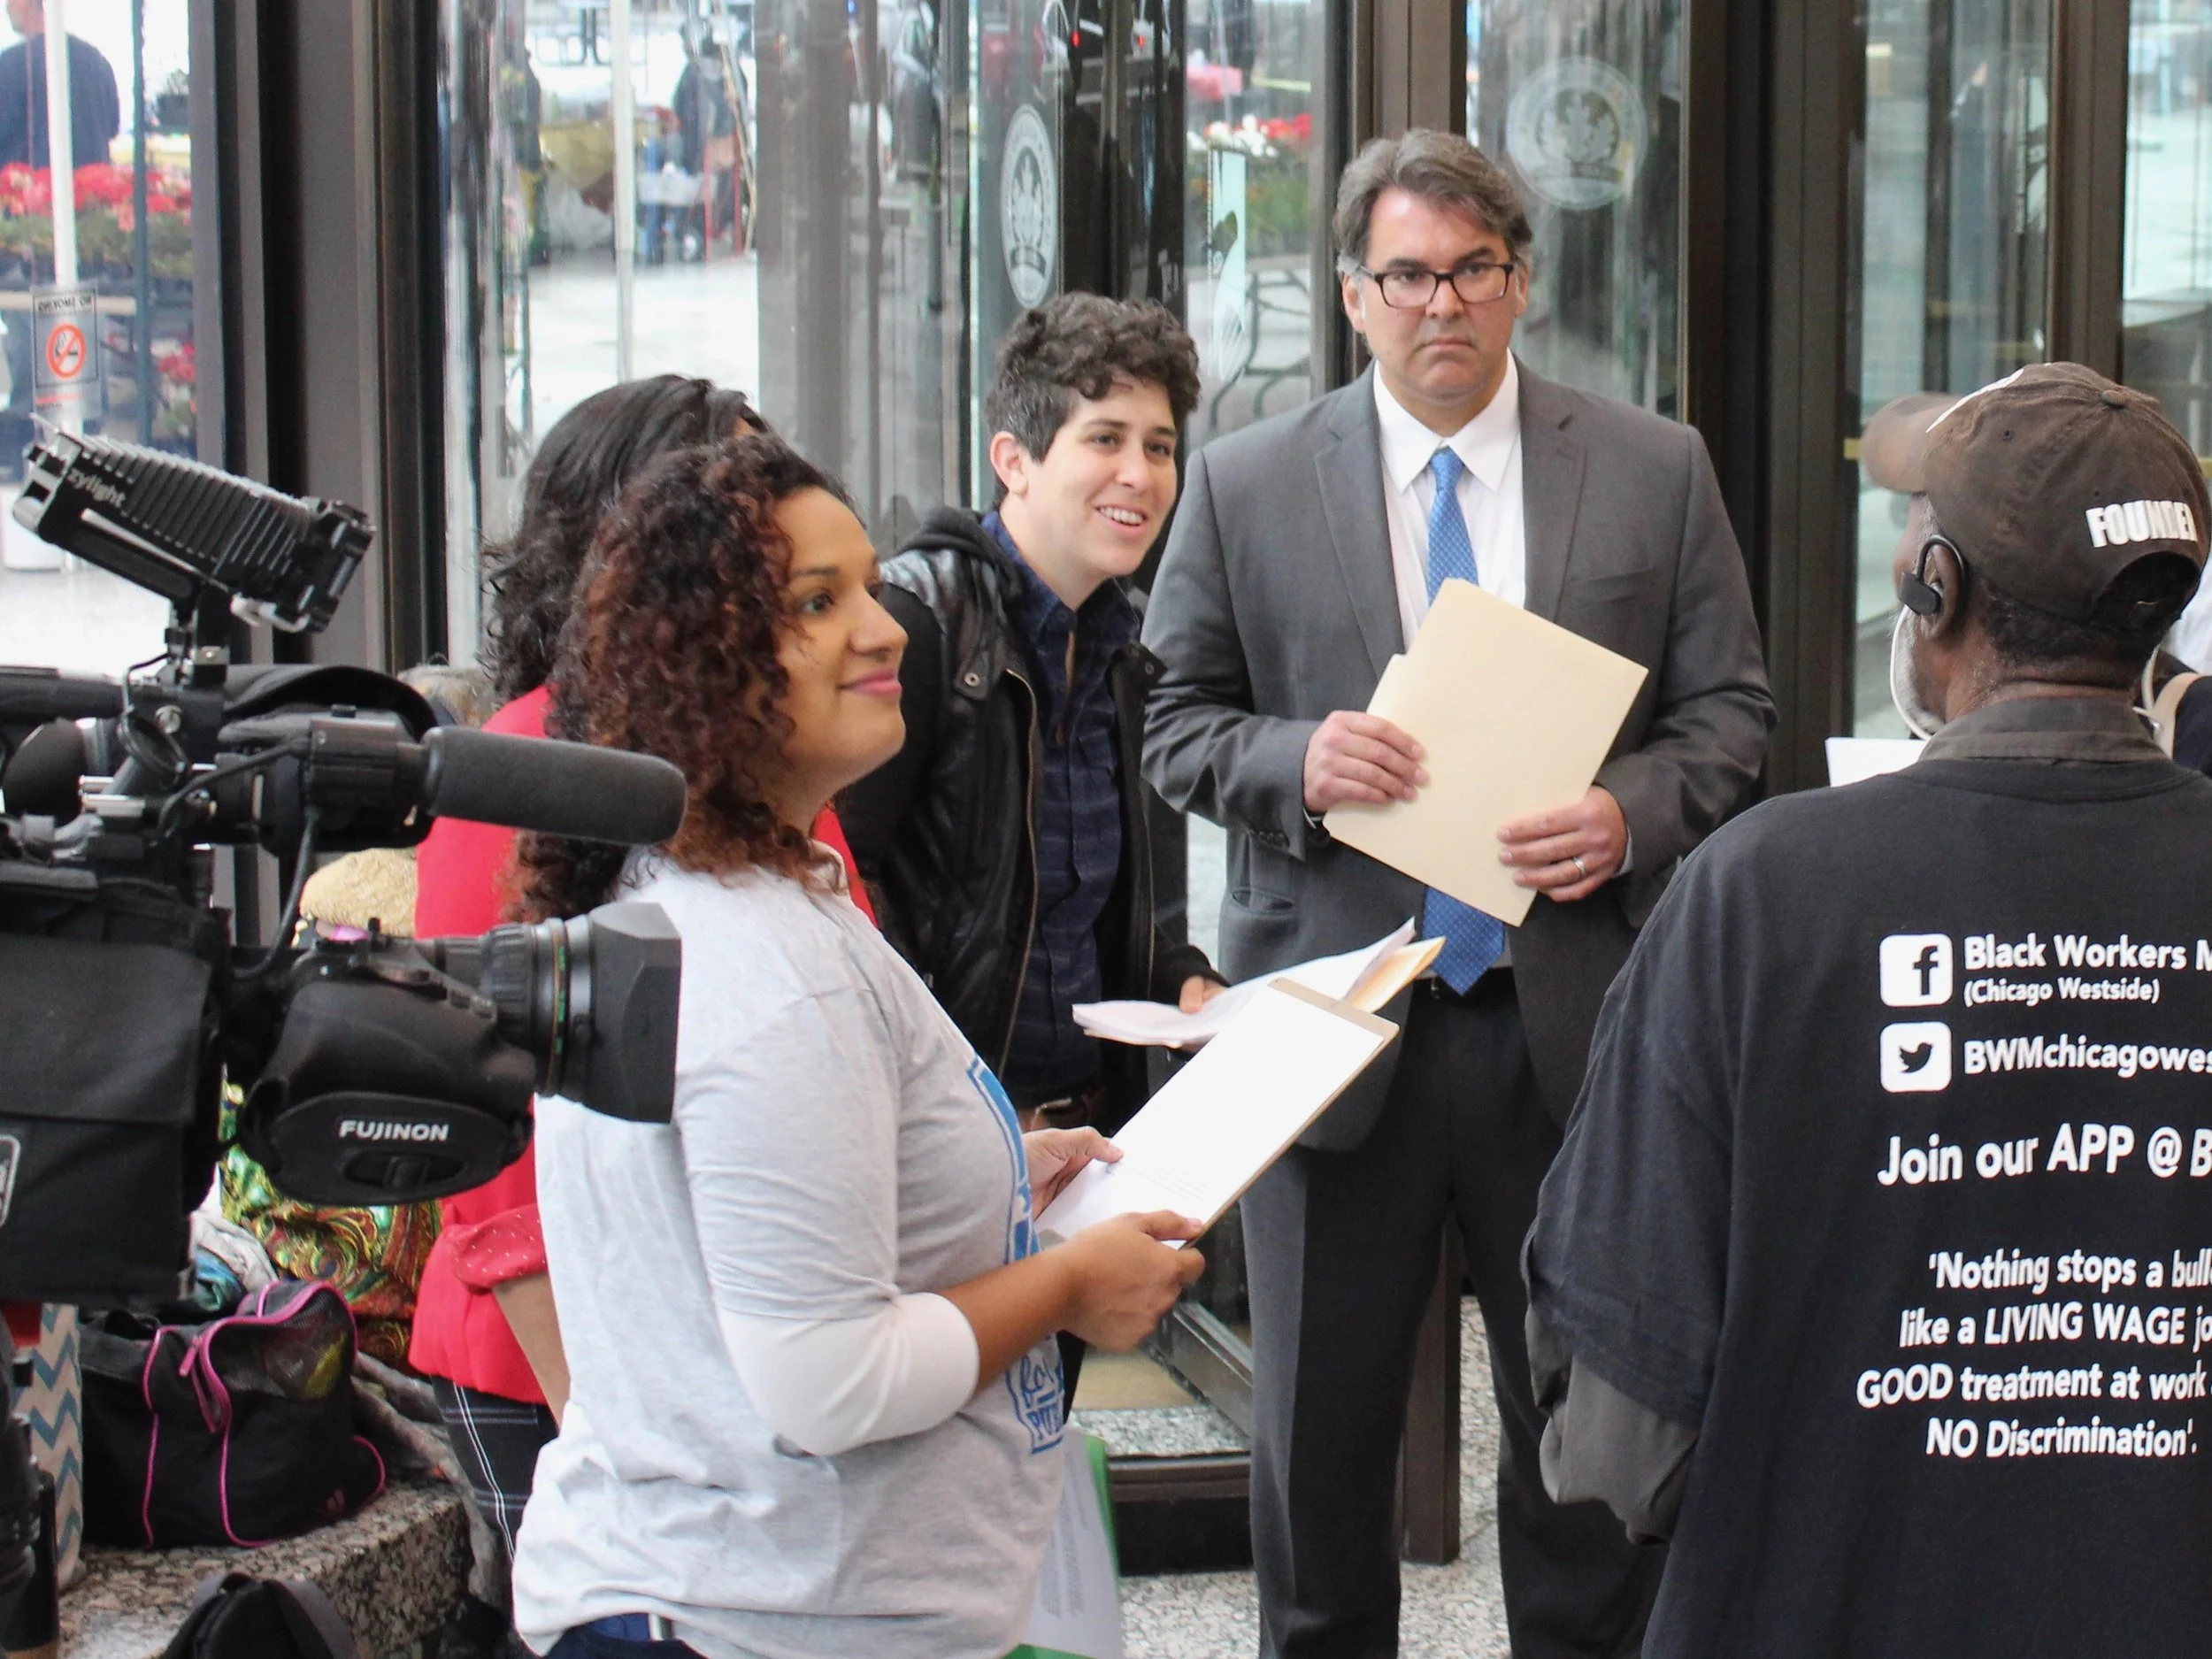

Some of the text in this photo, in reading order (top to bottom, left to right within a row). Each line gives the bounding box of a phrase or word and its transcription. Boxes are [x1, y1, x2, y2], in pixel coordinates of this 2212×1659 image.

[67, 467, 127, 510] zylight
[1964, 933, 2047, 970] Black
[2054, 934, 2186, 970] Workers
[1964, 977, 2160, 1007] (Chicago Westside)
[340, 1121, 448, 1141] FUJINON
[1878, 1133, 1962, 1186] Join
[1976, 1138, 2039, 1178] our
[2047, 1123, 2134, 1173] APP
[2147, 1127, 2182, 1178] @
[2057, 1249, 2136, 1294] stops
[2146, 1261, 2163, 1287] a
[2172, 1248, 2212, 1287] bull
[1900, 1308, 1949, 1348] like
[1957, 1317, 1976, 1344] a
[1985, 1302, 2083, 1344] LIVING
[2093, 1302, 2185, 1344] WAGE
[1856, 1360, 2207, 1408] GOOD treatment at work
[1926, 1417, 1978, 1458] NO
